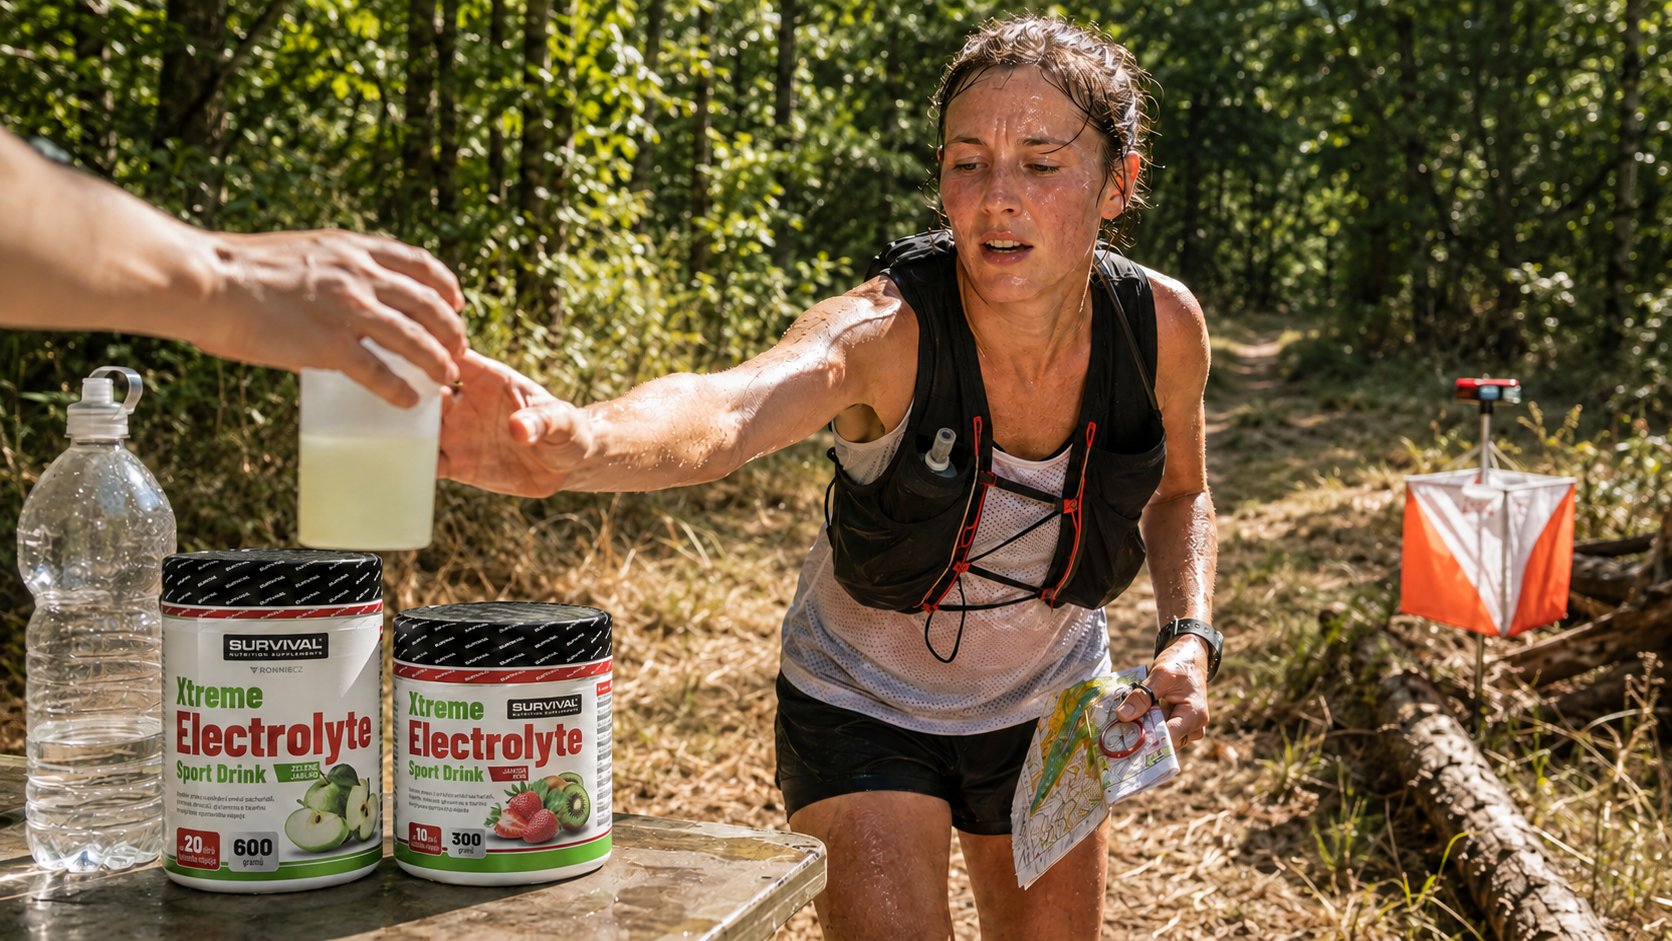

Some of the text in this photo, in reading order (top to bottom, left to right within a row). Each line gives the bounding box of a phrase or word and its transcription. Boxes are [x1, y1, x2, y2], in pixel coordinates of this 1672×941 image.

[176, 676, 264, 709] Xtreme
[408, 691, 485, 720] Xtreme
[176, 710, 373, 766] Electrolyte
[408, 719, 583, 768] Electrolyte
[176, 760, 267, 785] Sport Drink
[408, 760, 485, 782] Sport Drink
[184, 834, 203, 854] 20
[415, 827, 428, 842] 10
[452, 832, 482, 846] 300
[233, 838, 273, 857] 600
